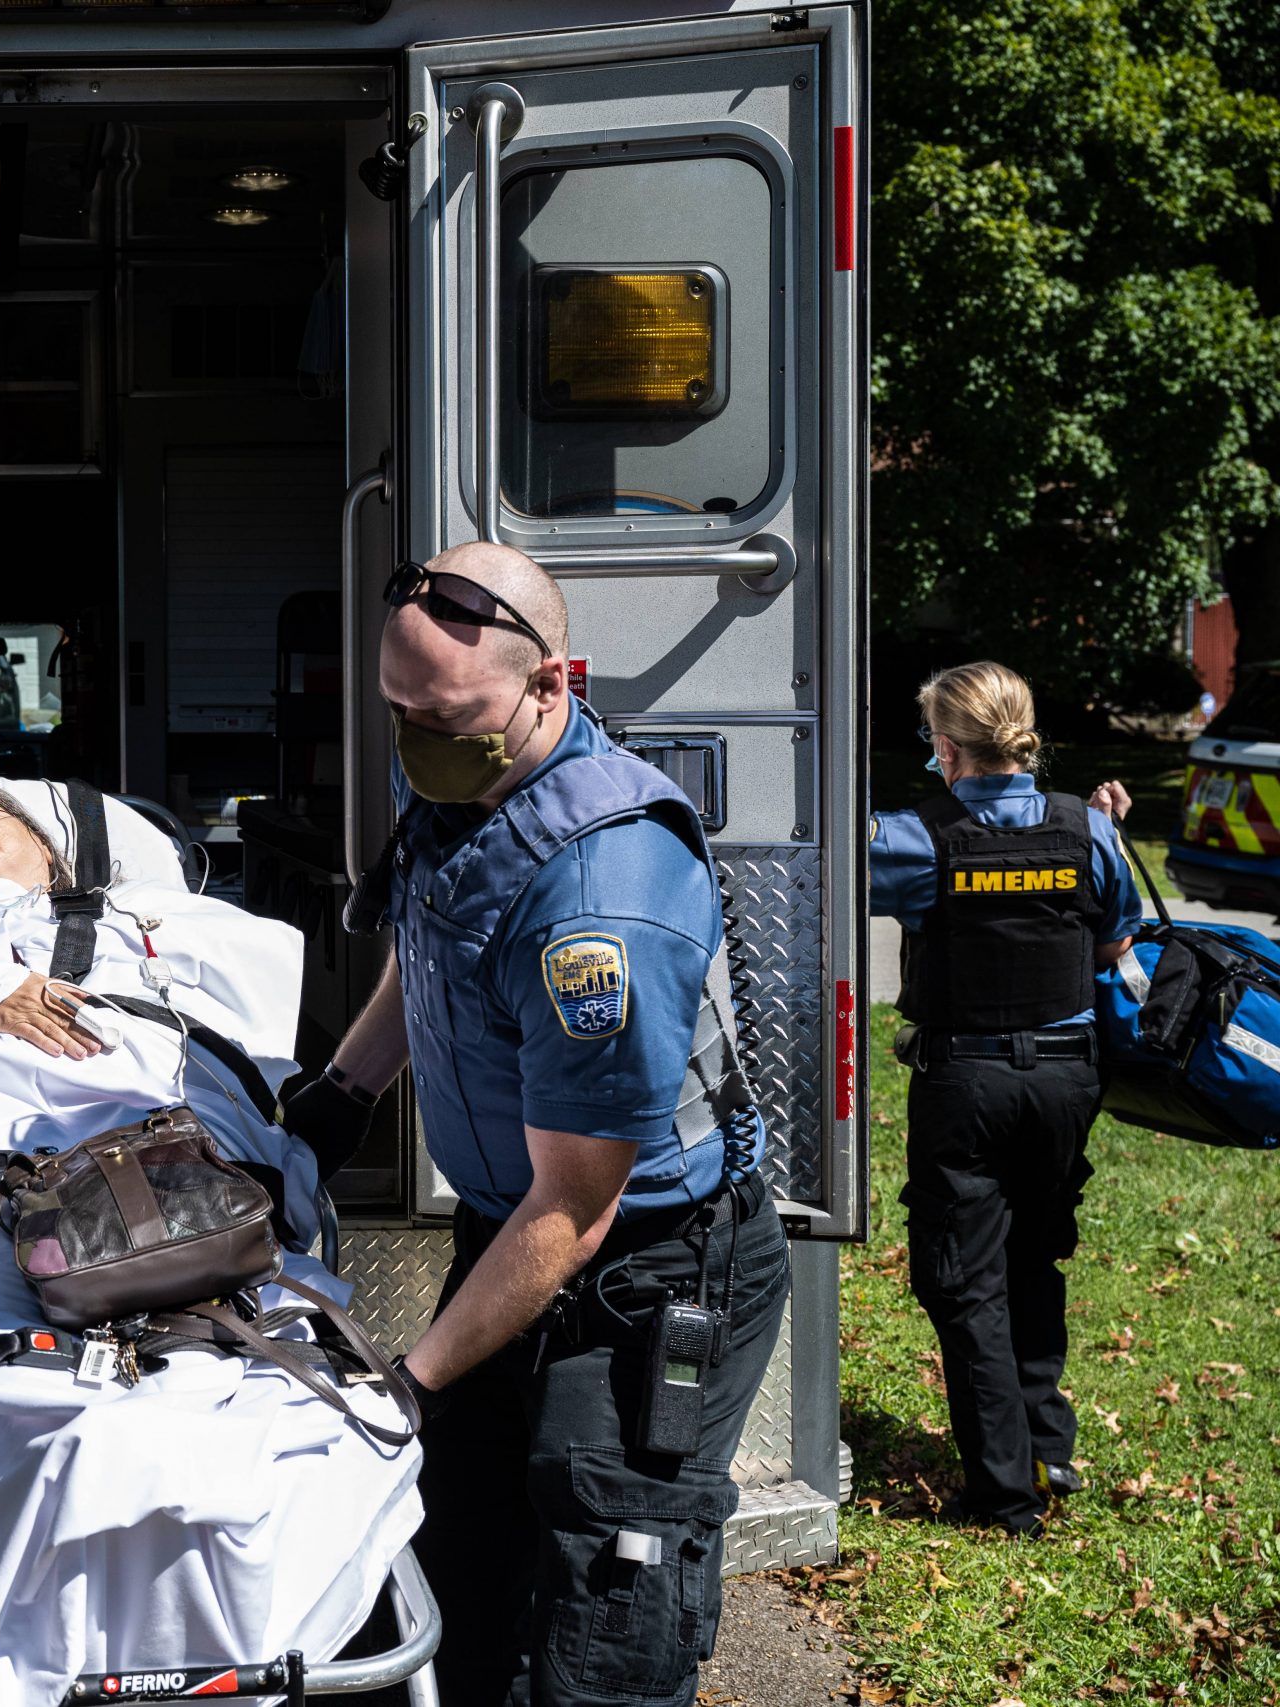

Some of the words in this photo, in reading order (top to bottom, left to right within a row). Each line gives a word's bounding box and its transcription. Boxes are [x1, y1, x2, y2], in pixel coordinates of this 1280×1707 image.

[568, 673, 583, 681] hile
[568, 682, 585, 690] eath
[954, 868, 1078, 892] LMEMS
[554, 951, 614, 972] Louisville
[563, 969, 581, 980] EMS
[120, 1672, 186, 1693] FERNO
